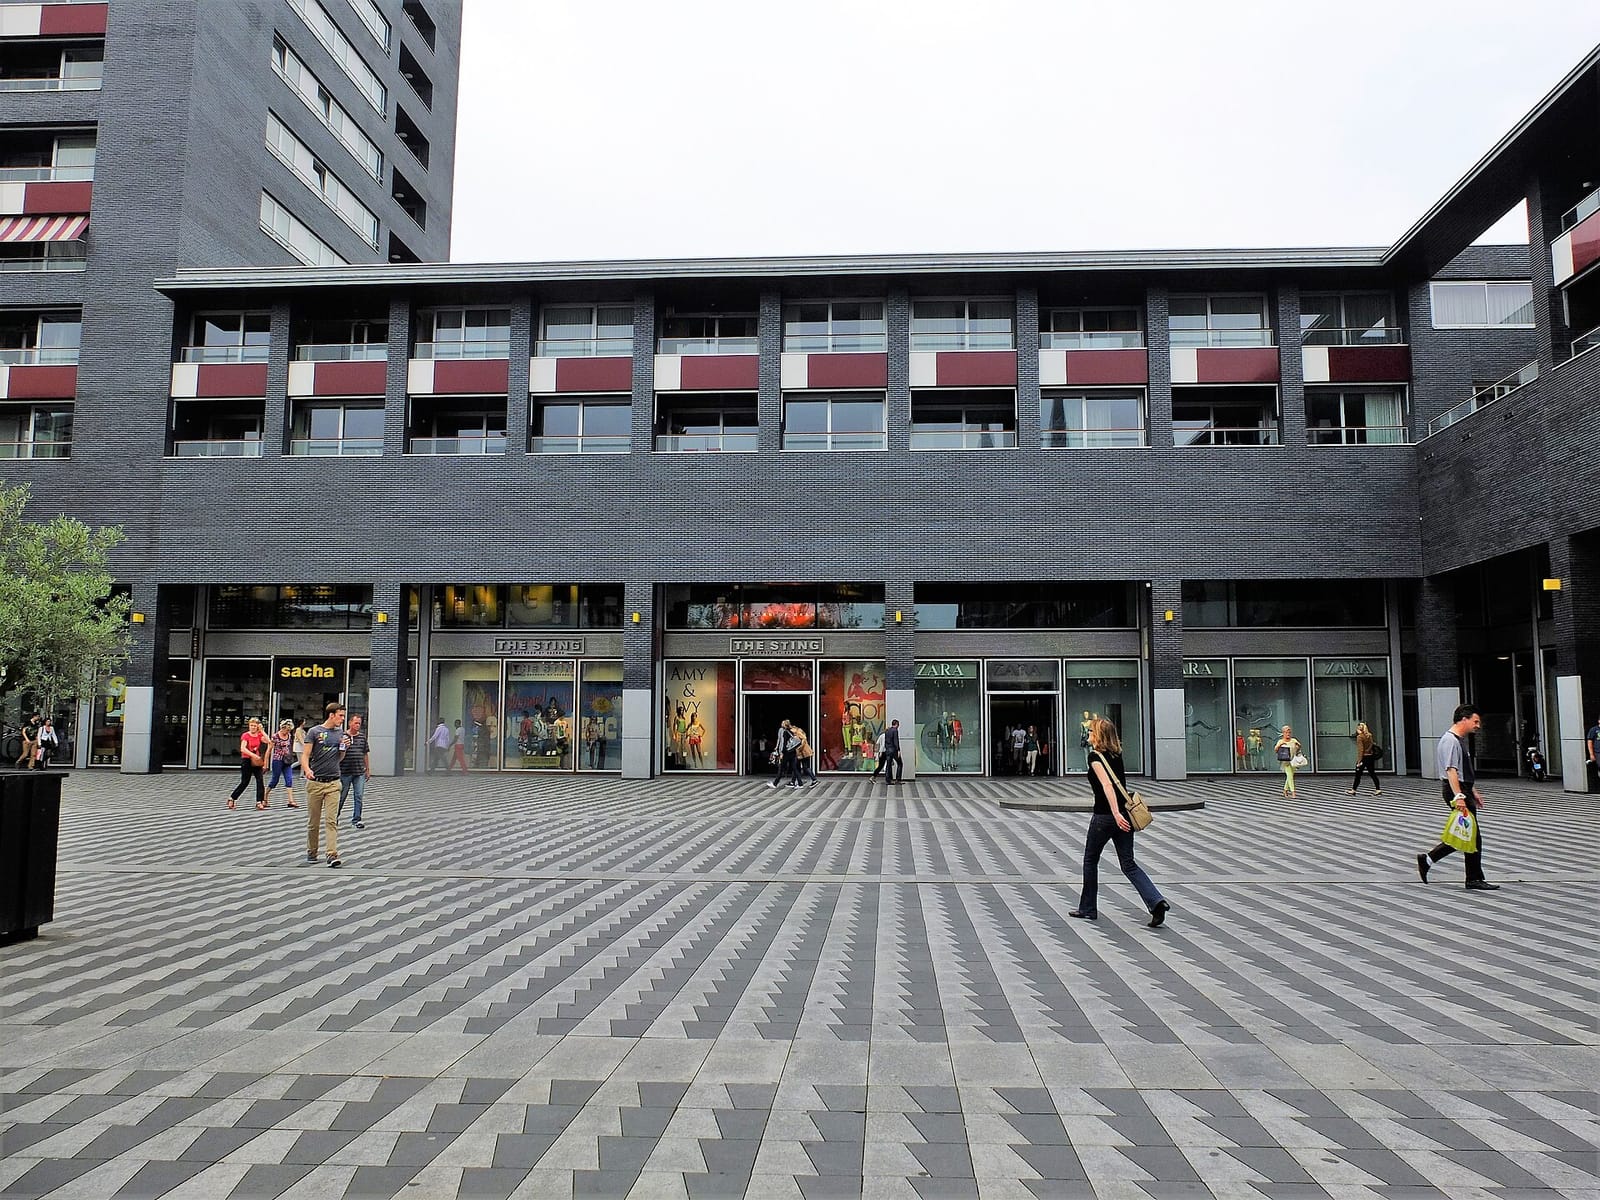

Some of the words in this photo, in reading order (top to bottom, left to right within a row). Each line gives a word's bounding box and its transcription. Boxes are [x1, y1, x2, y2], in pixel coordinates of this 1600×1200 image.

[496, 640, 528, 650] THE
[531, 640, 581, 650] STING
[733, 640, 765, 650] THE
[769, 640, 820, 650] STING
[280, 664, 335, 678] sacha
[543, 664, 574, 673] STIN
[670, 666, 707, 681] AMY
[917, 663, 964, 676] ZARA
[993, 664, 1041, 676] ZARA
[1325, 662, 1374, 675] ZARA
[682, 682, 696, 698] &
